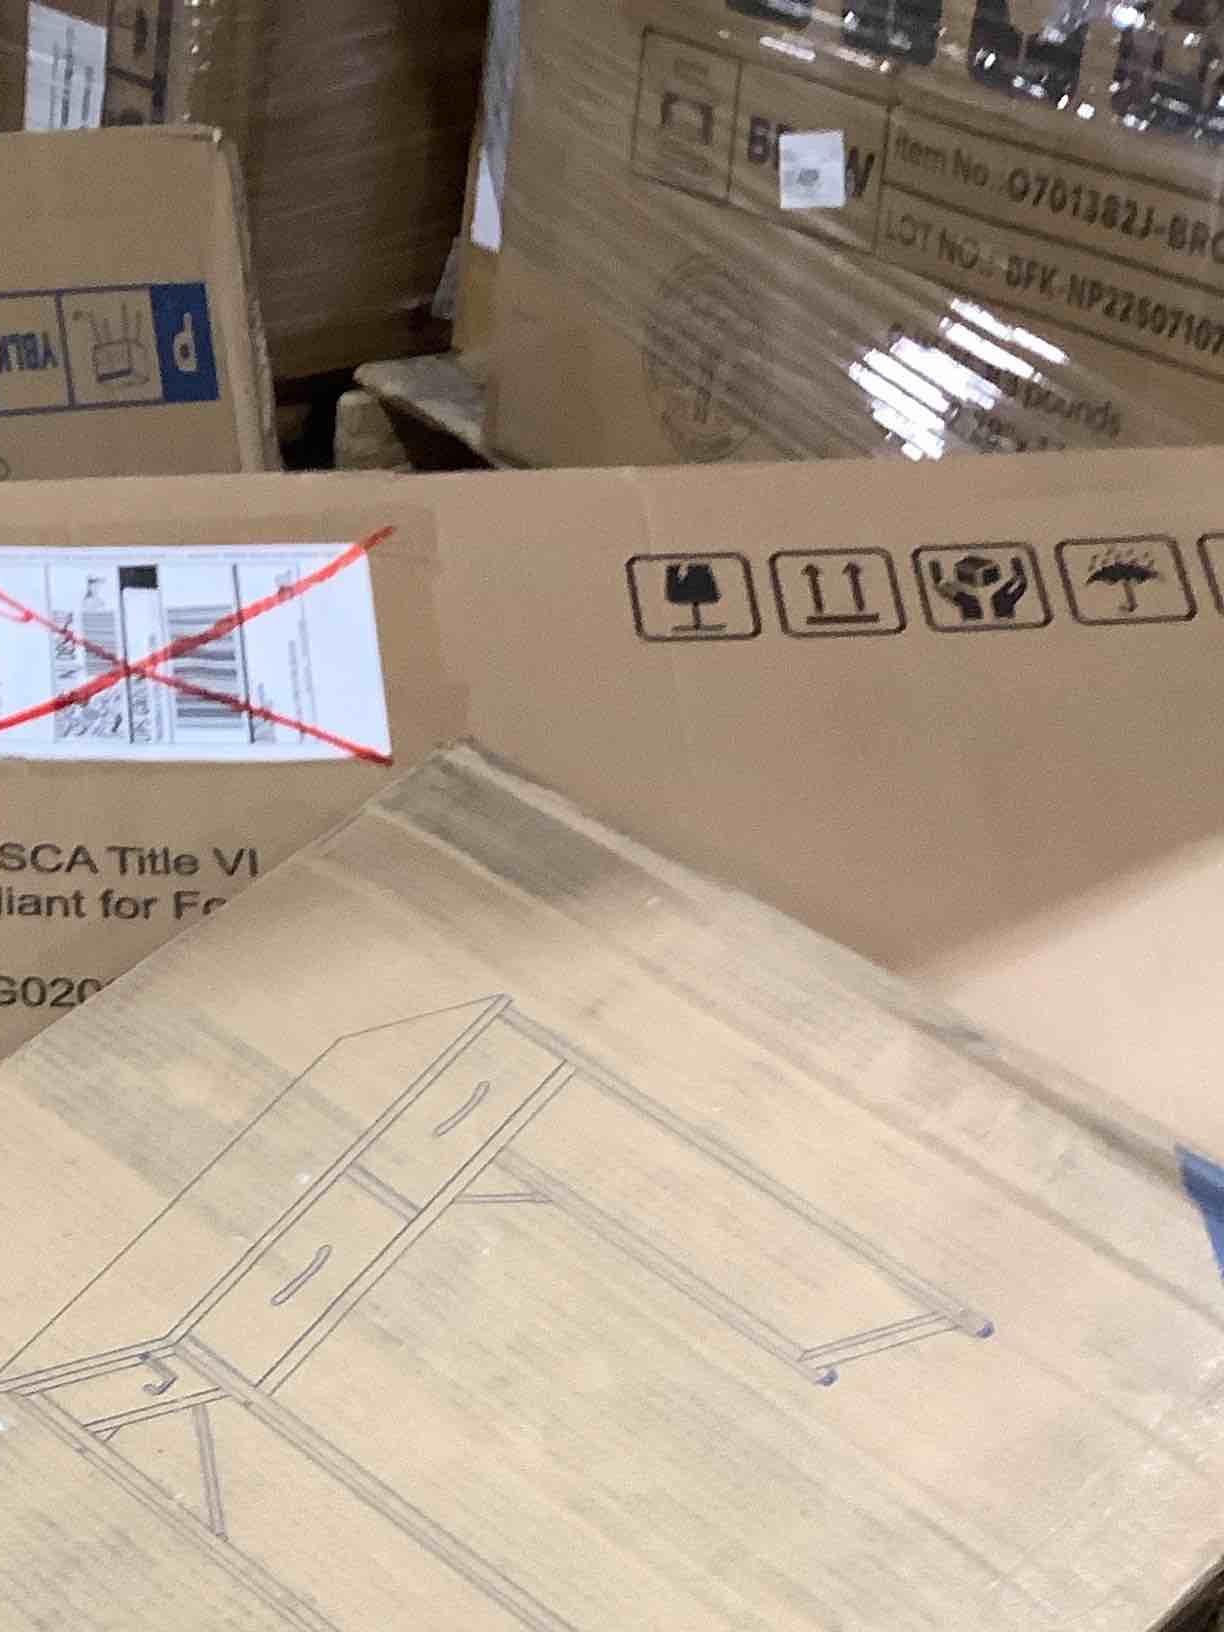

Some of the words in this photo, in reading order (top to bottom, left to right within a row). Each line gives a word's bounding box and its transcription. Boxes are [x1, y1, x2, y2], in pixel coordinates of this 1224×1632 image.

[107, 844, 200, 877] Title
[212, 847, 259, 877] VI
[99, 890, 153, 920] for
